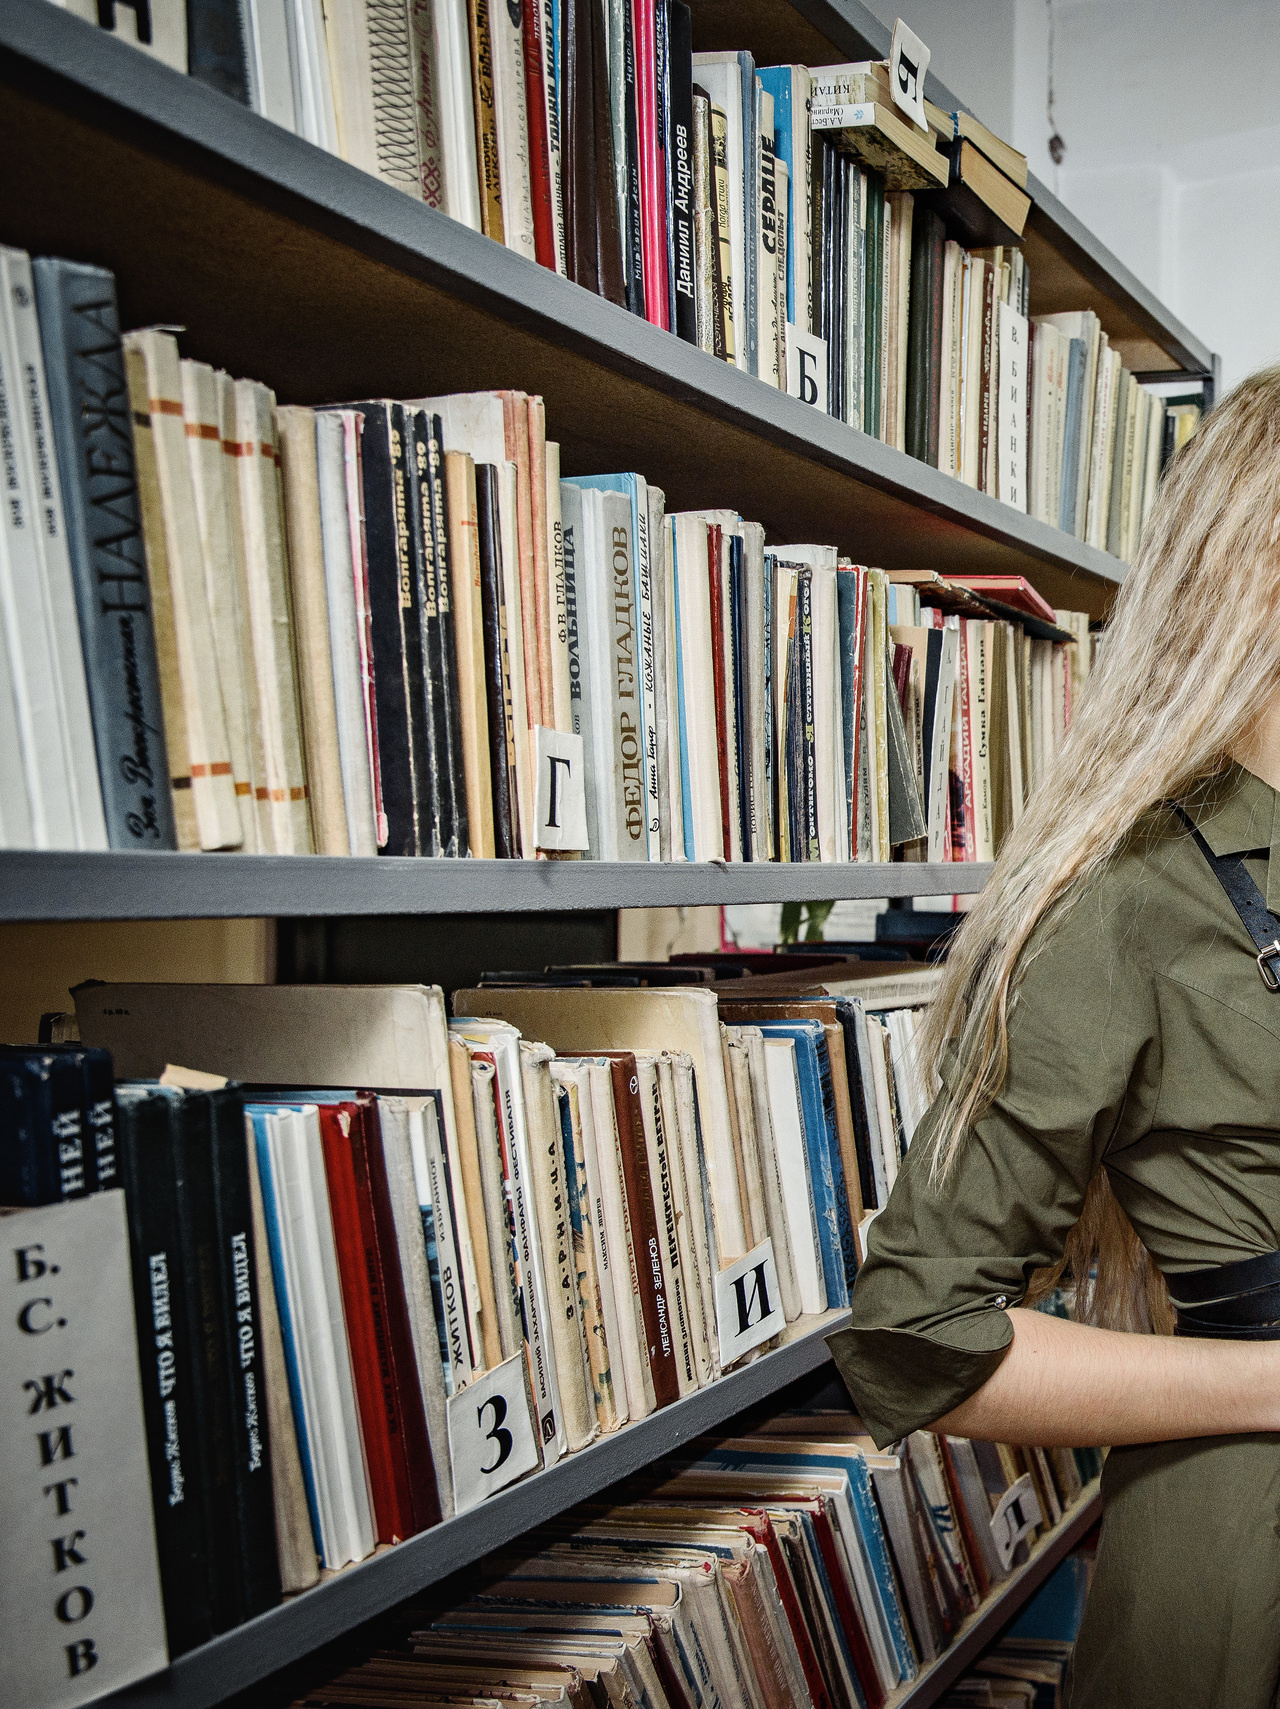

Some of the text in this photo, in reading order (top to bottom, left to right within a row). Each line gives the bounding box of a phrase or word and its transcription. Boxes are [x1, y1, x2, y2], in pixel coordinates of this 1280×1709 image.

[674, 124, 694, 299] Даниил Андреев
[716, 178, 727, 229] Когда стихи
[760, 134, 776, 254] СЕРДЦЕ
[776, 209, 785, 282] СЛЕДОПЫТ
[796, 346, 819, 406] Б
[1009, 360, 1018, 504] БИАНКИ
[552, 520, 567, 606] ГЛАДКОВ
[563, 524, 582, 701] ВОЛЬНИЦА
[611, 526, 645, 840] ФЕДОР ГЛАДКОВ
[642, 610, 654, 693] КОЖАНЫЕ
[977, 638, 986, 704] Гайдара
[958, 634, 973, 809] АРКАДИЙ ГАЙДАР
[978, 709, 988, 758] Сумка
[544, 754, 572, 830] Г
[646, 762, 658, 800] Анна
[504, 1090, 520, 1180] ФЕСТИВАЛЯ
[516, 1186, 530, 1262] ФАНФАРЫ
[598, 1231, 609, 1271] МАКСИМ
[149, 1252, 171, 1331] ВИДЕЛ
[231, 1231, 252, 1307] ВИДЕЛ
[429, 1157, 464, 1370] ЖИТКОВ ИЗБРАННОЕ
[625, 1242, 640, 1296] ЦВЕТЫ
[647, 1237, 663, 1291] ЗЕЛЕНОВ
[729, 1256, 778, 1340] И
[155, 1330, 174, 1348] Я
[236, 1306, 253, 1323] Я
[526, 1270, 541, 1343] ЗАХАРЧЕНКО
[156, 1350, 177, 1398] ЧТО
[237, 1325, 255, 1369] ЧТО
[534, 1346, 548, 1400] ВАСИЛИЙ
[13, 1242, 99, 1681] Б. С. ЖИТКОВ
